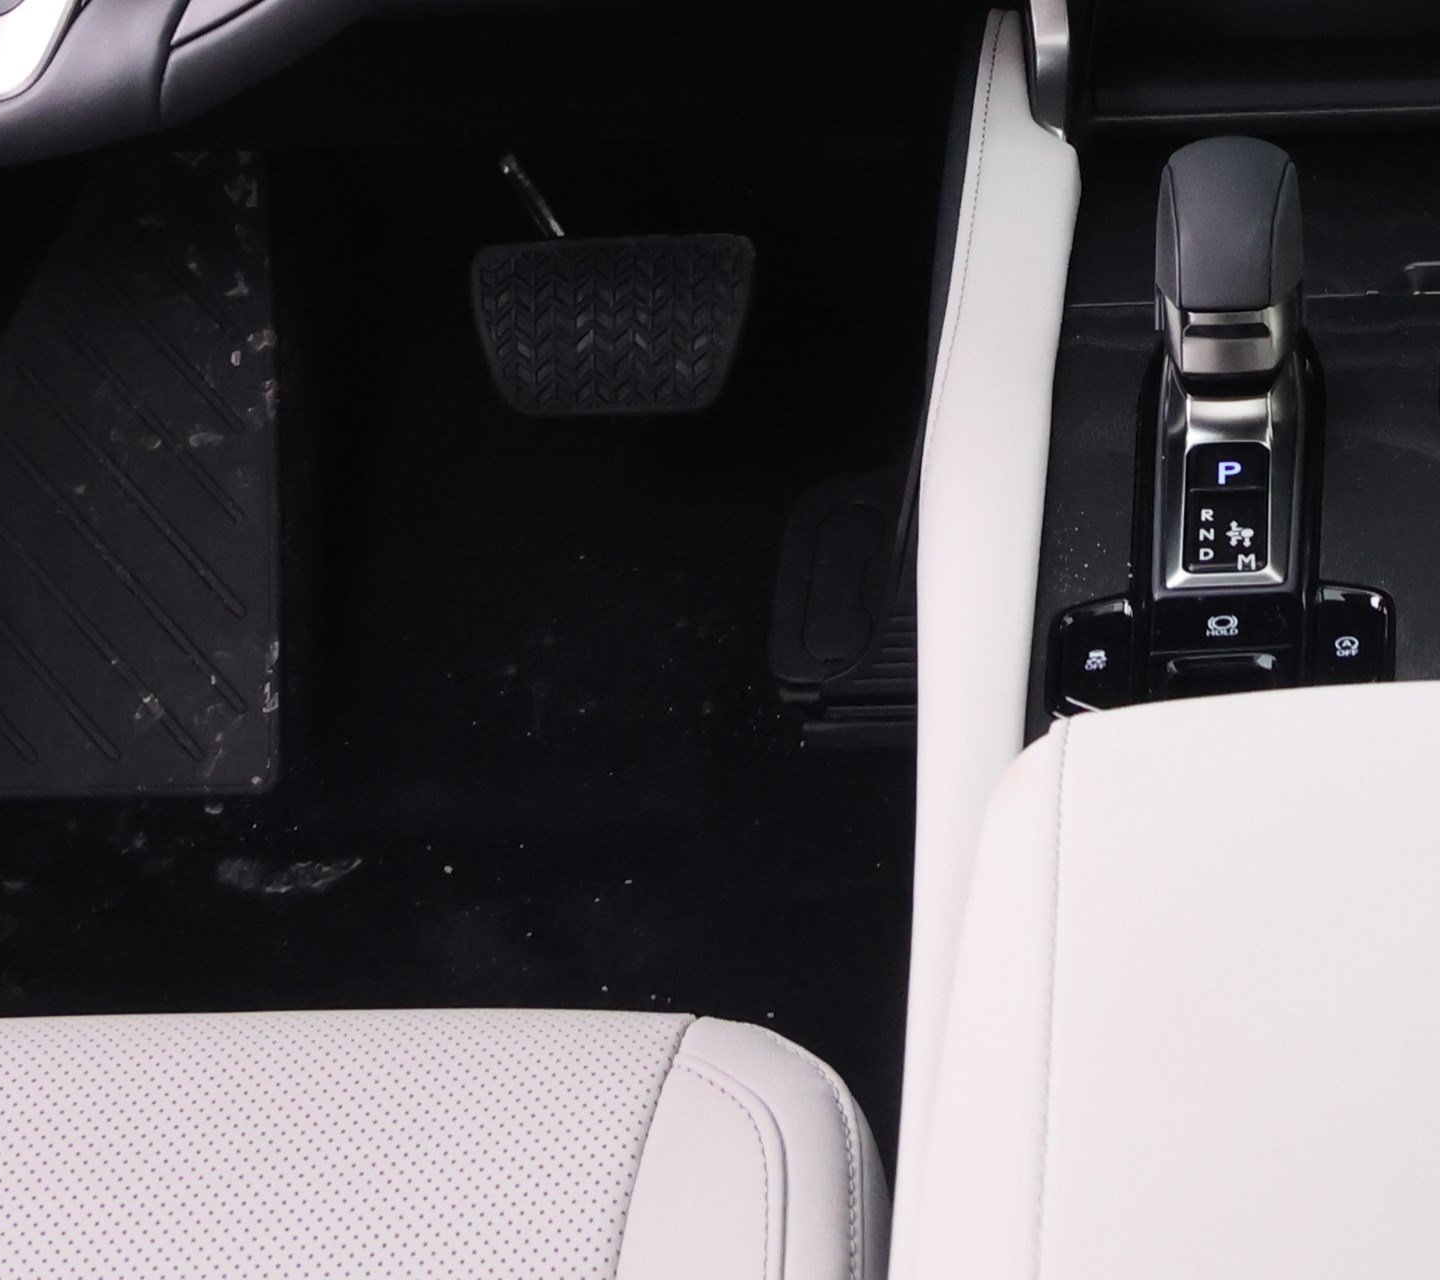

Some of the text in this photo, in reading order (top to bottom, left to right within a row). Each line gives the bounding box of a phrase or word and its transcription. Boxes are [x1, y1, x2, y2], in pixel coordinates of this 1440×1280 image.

[1217, 461, 1242, 485] P
[1201, 508, 1214, 522] R
[1199, 528, 1215, 541] N
[1199, 548, 1214, 561] D
[1237, 553, 1256, 571] M
[1206, 627, 1239, 636] HOLD
[1336, 648, 1359, 657] OFF
[1085, 660, 1107, 670] OFF
